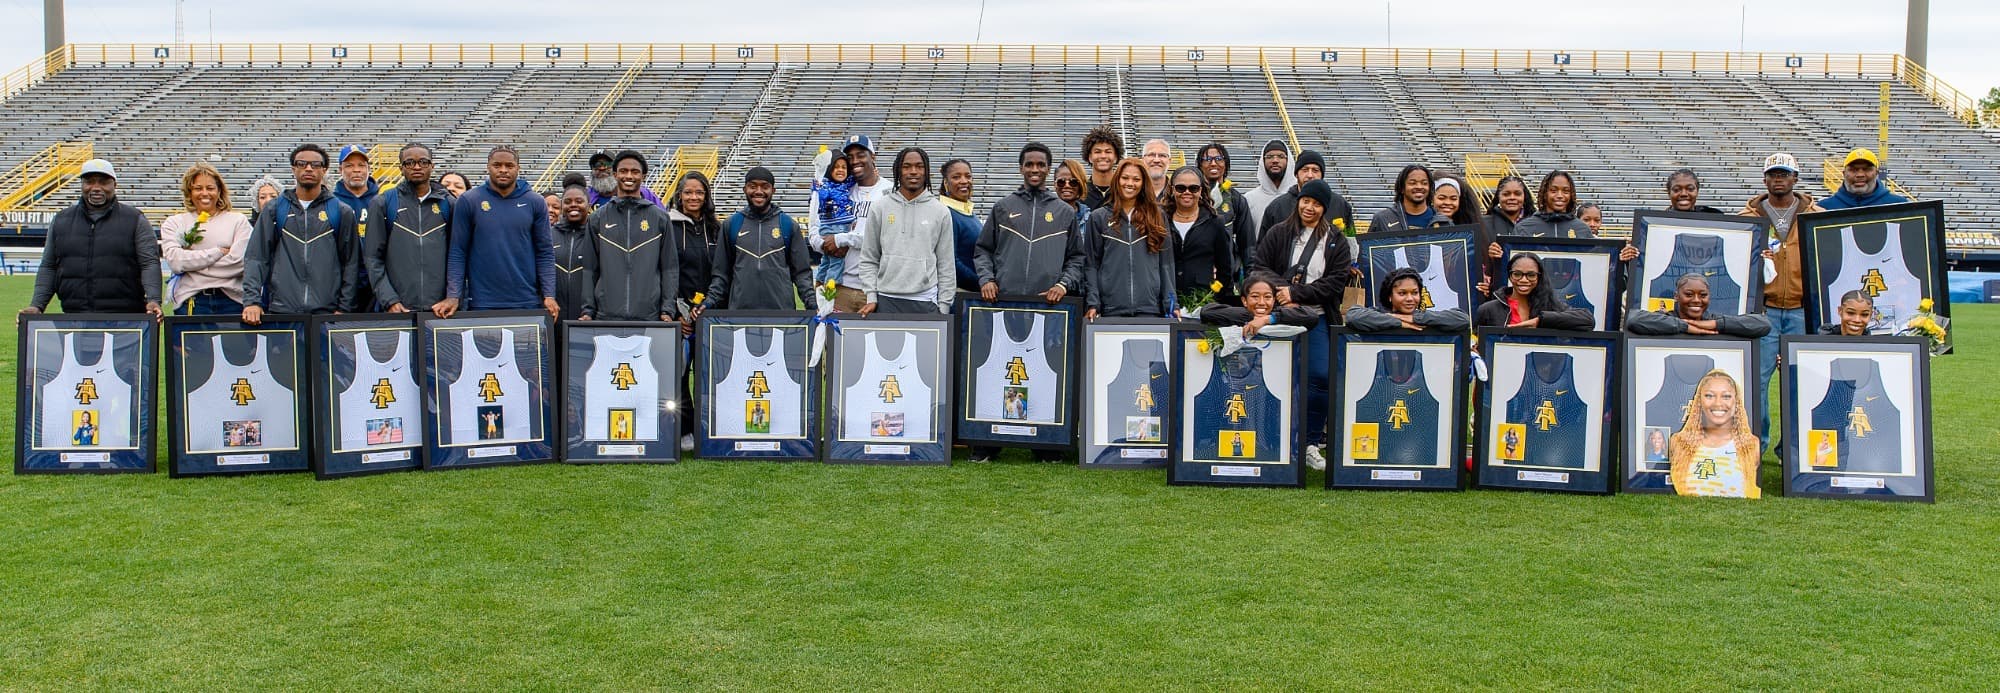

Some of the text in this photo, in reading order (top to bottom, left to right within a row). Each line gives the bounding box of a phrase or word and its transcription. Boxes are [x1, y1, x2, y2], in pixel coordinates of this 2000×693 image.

[157, 48, 167, 57] A
[335, 48, 345, 57] B
[548, 48, 558, 57] C
[740, 48, 753, 58] D1
[929, 49, 943, 58] D2
[1189, 50, 1203, 60] D3
[1324, 52, 1335, 62] E
[1556, 55, 1567, 64] F
[1788, 58, 1800, 67] G
[5, 211, 26, 223] YOU
[27, 211, 43, 223] FIT
